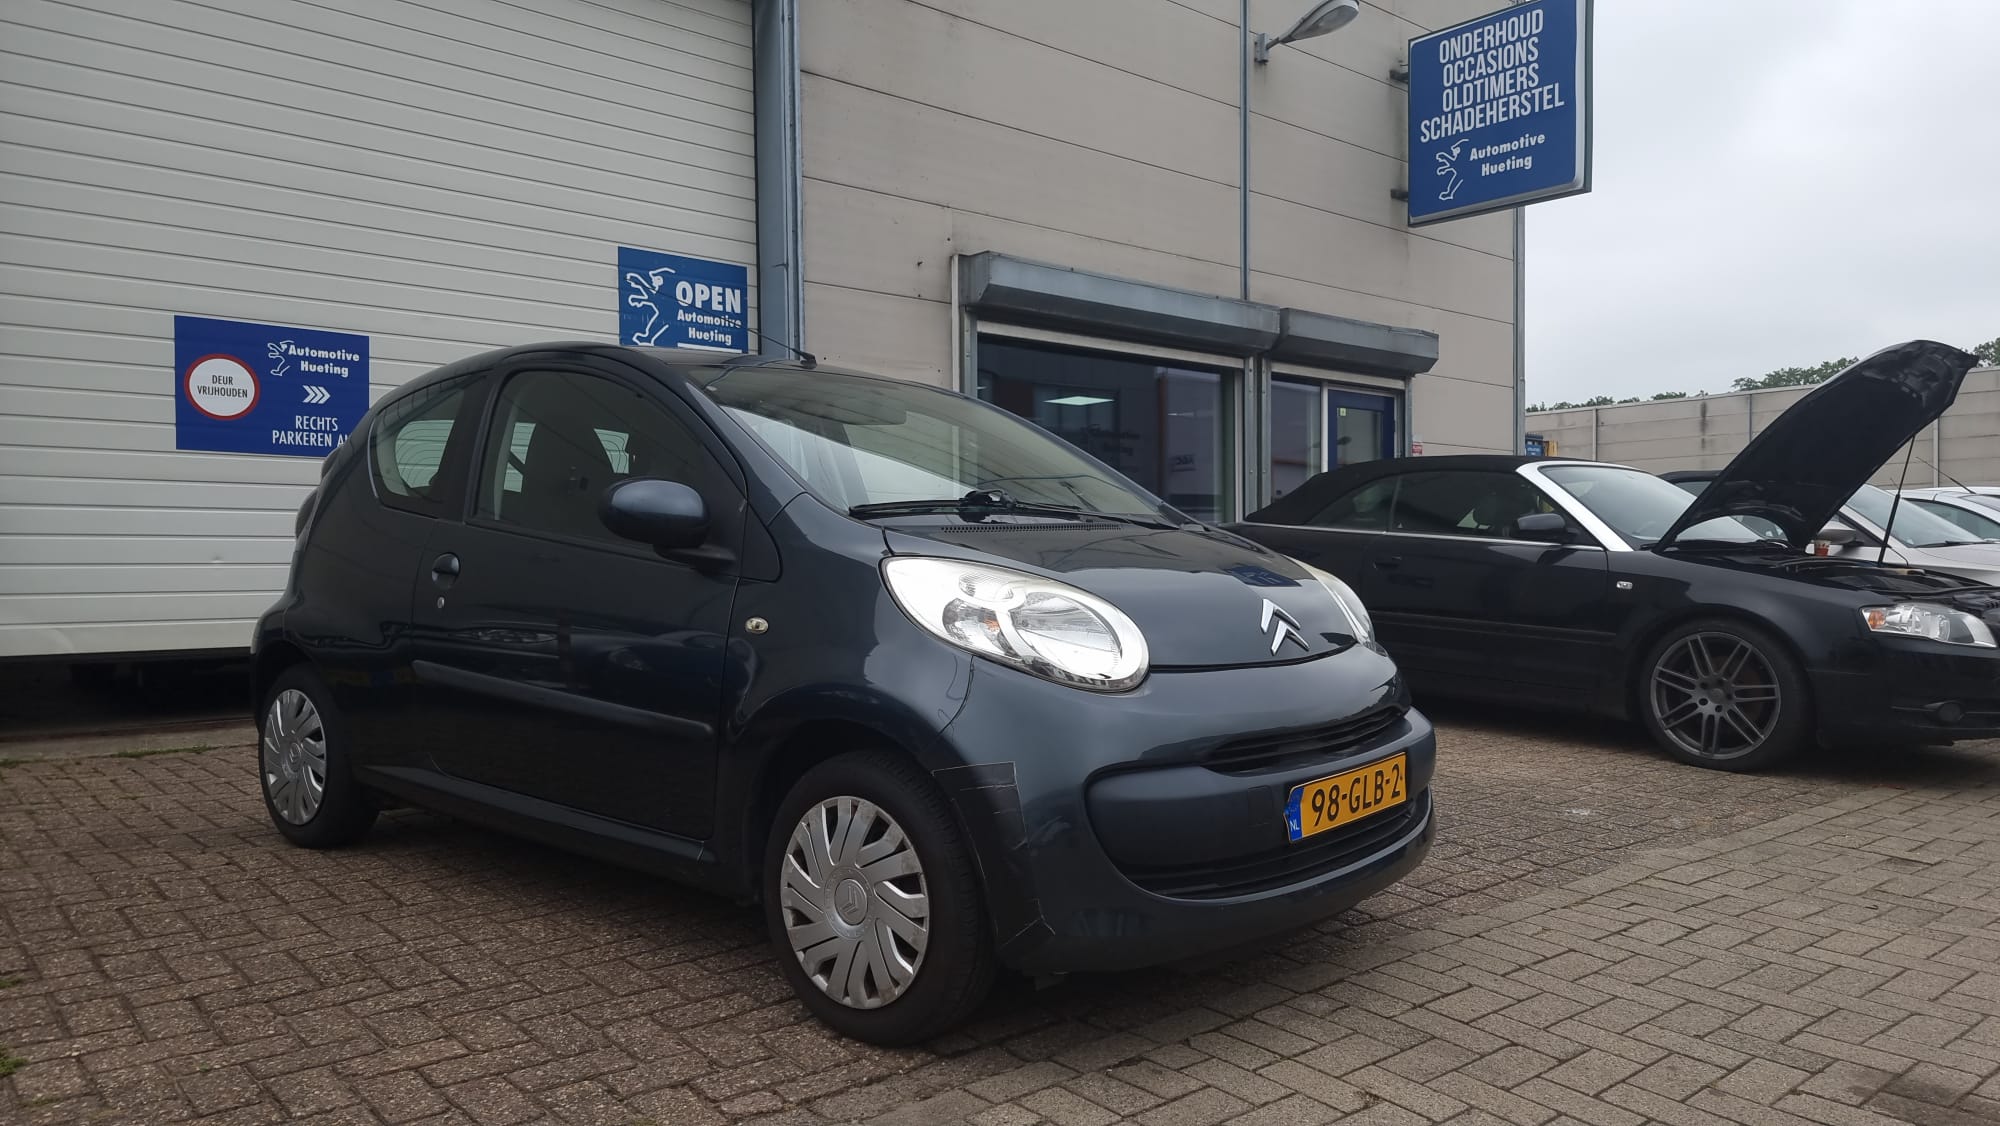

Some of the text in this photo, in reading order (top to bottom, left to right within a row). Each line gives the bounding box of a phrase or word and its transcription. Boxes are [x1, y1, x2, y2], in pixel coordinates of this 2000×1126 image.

[1439, 8, 1544, 64] ONDERHOUD
[1442, 36, 1539, 88] OCCASIONS
[1442, 62, 1539, 113] OLDTIMERS
[1420, 82, 1565, 144] SCHADEHERSTEL
[1469, 133, 1546, 161] Automotive
[1481, 155, 1533, 177] Hueting
[675, 280, 741, 314] OPEN
[677, 309, 742, 329] Automotive
[688, 326, 732, 346] Hueting
[288, 344, 360, 362] Automotive
[300, 360, 349, 378] Hueting
[211, 374, 234, 386] DEUR
[197, 385, 248, 398] VRIJHOUDEN
[295, 415, 339, 432] RECHTS
[272, 430, 332, 447] PARKEREN
[1311, 763, 1401, 827] 98-GLB-2
[1289, 819, 1300, 832] NL
